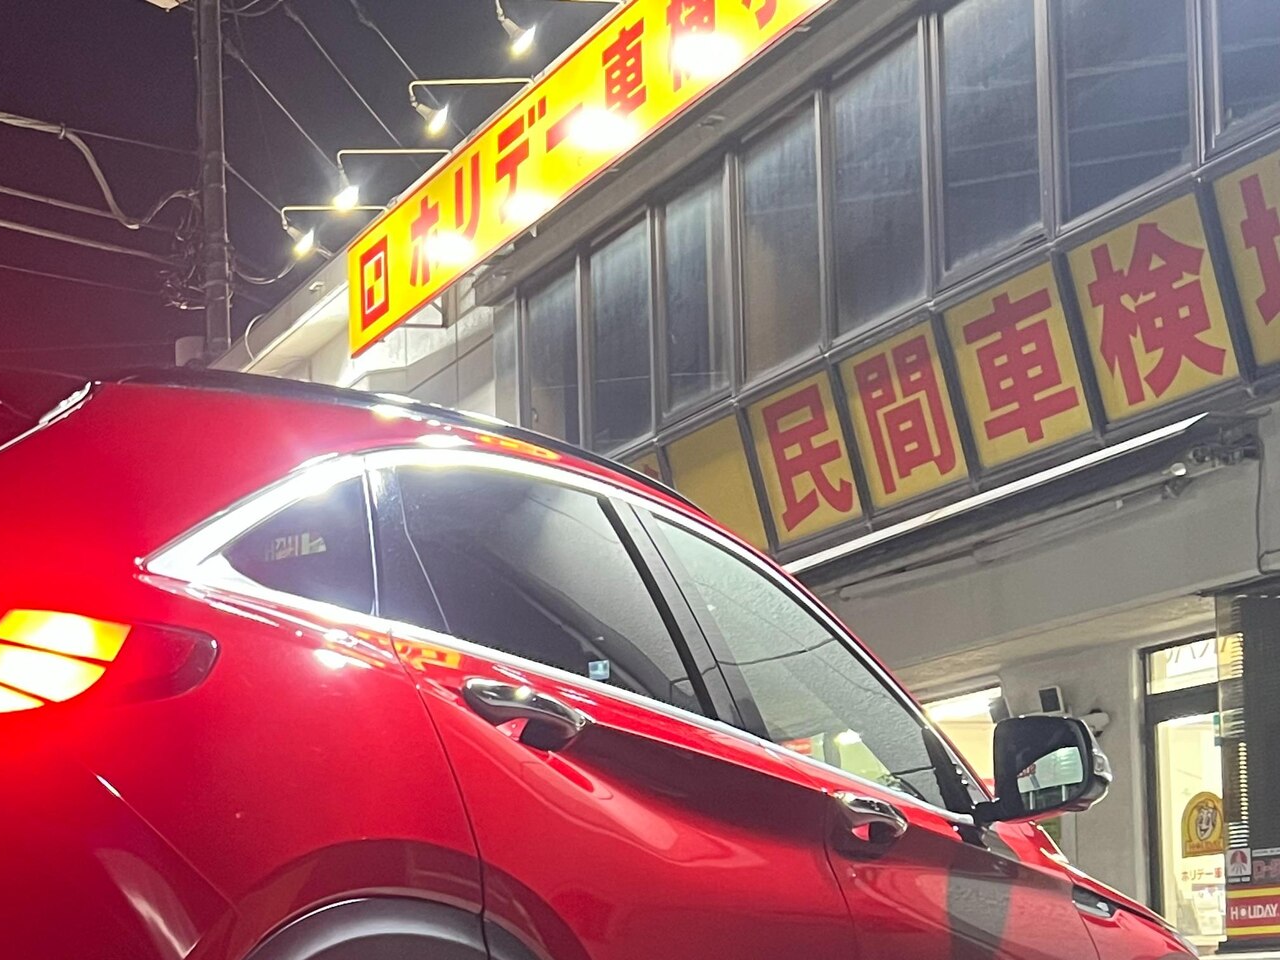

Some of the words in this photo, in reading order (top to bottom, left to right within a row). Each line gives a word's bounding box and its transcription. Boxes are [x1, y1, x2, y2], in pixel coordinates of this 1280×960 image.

[410, 0, 777, 287] ホリデー車
